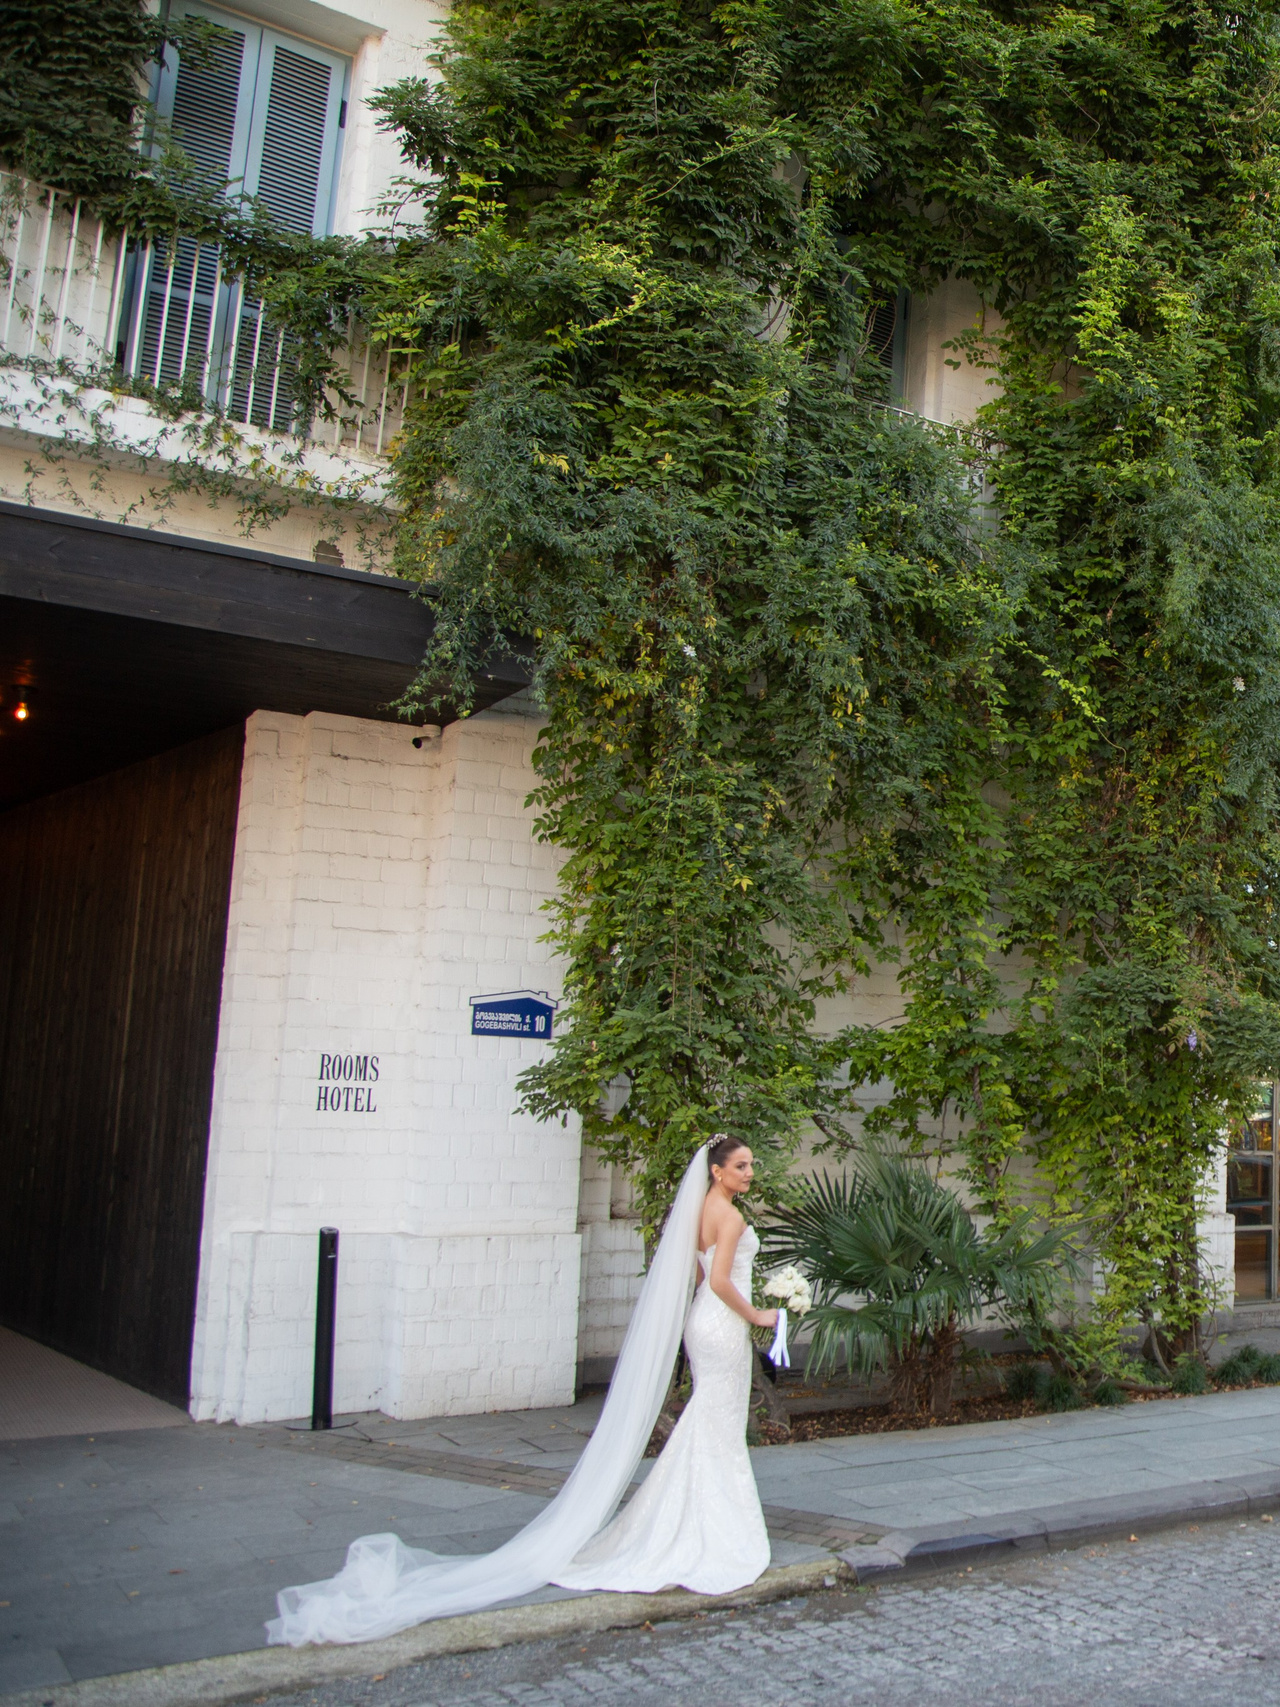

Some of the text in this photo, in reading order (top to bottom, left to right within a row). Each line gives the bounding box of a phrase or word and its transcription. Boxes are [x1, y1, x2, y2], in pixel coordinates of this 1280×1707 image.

[475, 1020, 531, 1031] GOGEBASHVILI st.
[535, 1015, 546, 1032] 10
[318, 1053, 379, 1082] ROOMS
[316, 1086, 377, 1112] HOTEL
